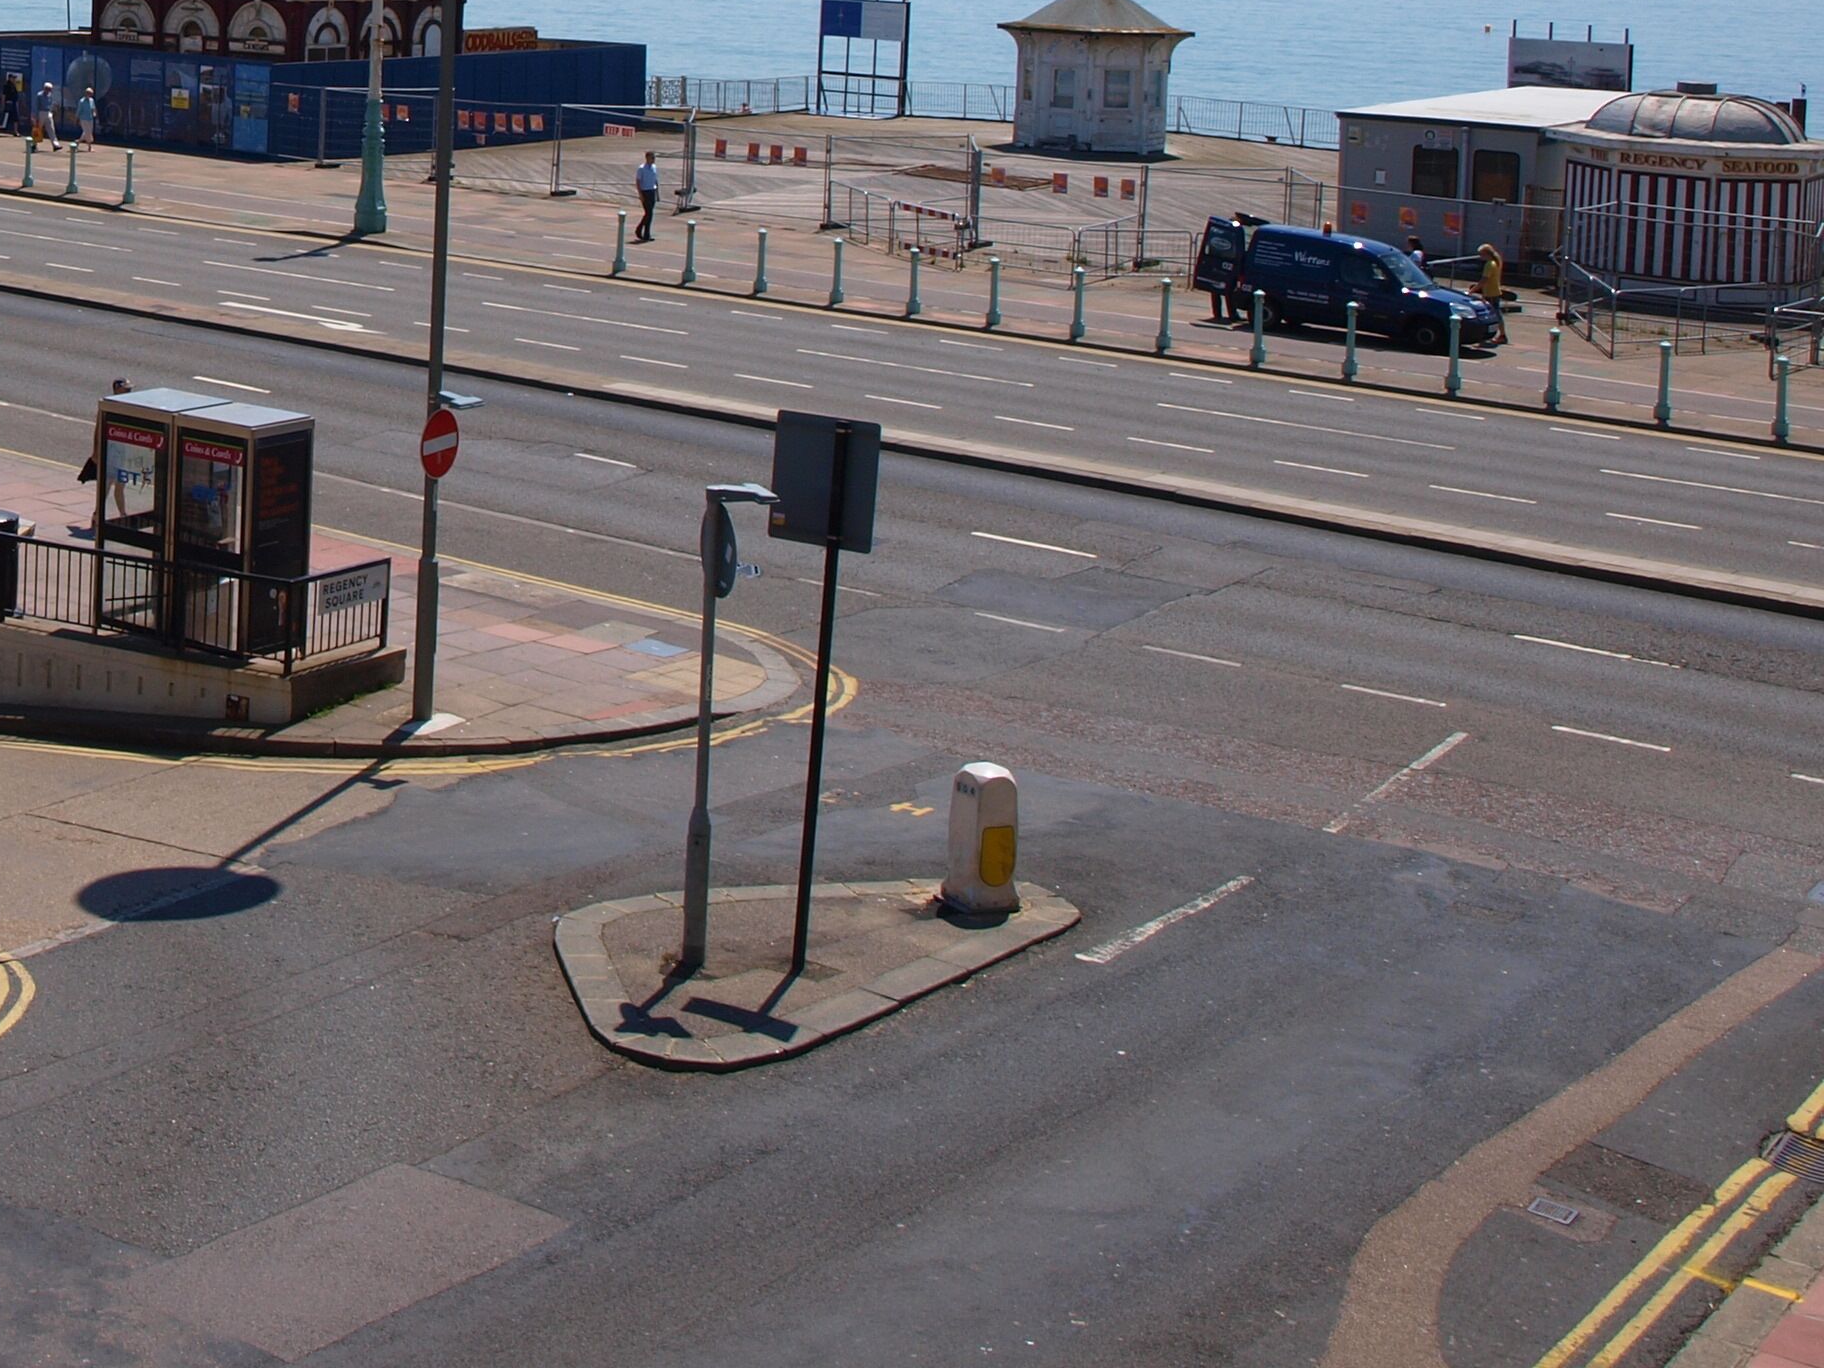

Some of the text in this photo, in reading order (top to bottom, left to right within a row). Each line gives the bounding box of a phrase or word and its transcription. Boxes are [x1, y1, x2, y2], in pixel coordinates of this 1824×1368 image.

[605, 126, 619, 135] KEEP
[1590, 148, 1608, 162] THE
[1620, 151, 1707, 171] REGENCY
[1722, 160, 1800, 175] SEAFOOD
[108, 427, 128, 439] Coins
[133, 431, 153, 444] Cards
[185, 442, 232, 459] Coins & Cards
[116, 469, 141, 486] BT
[323, 574, 368, 595] REGENCY
[325, 589, 364, 609] SQUARE
